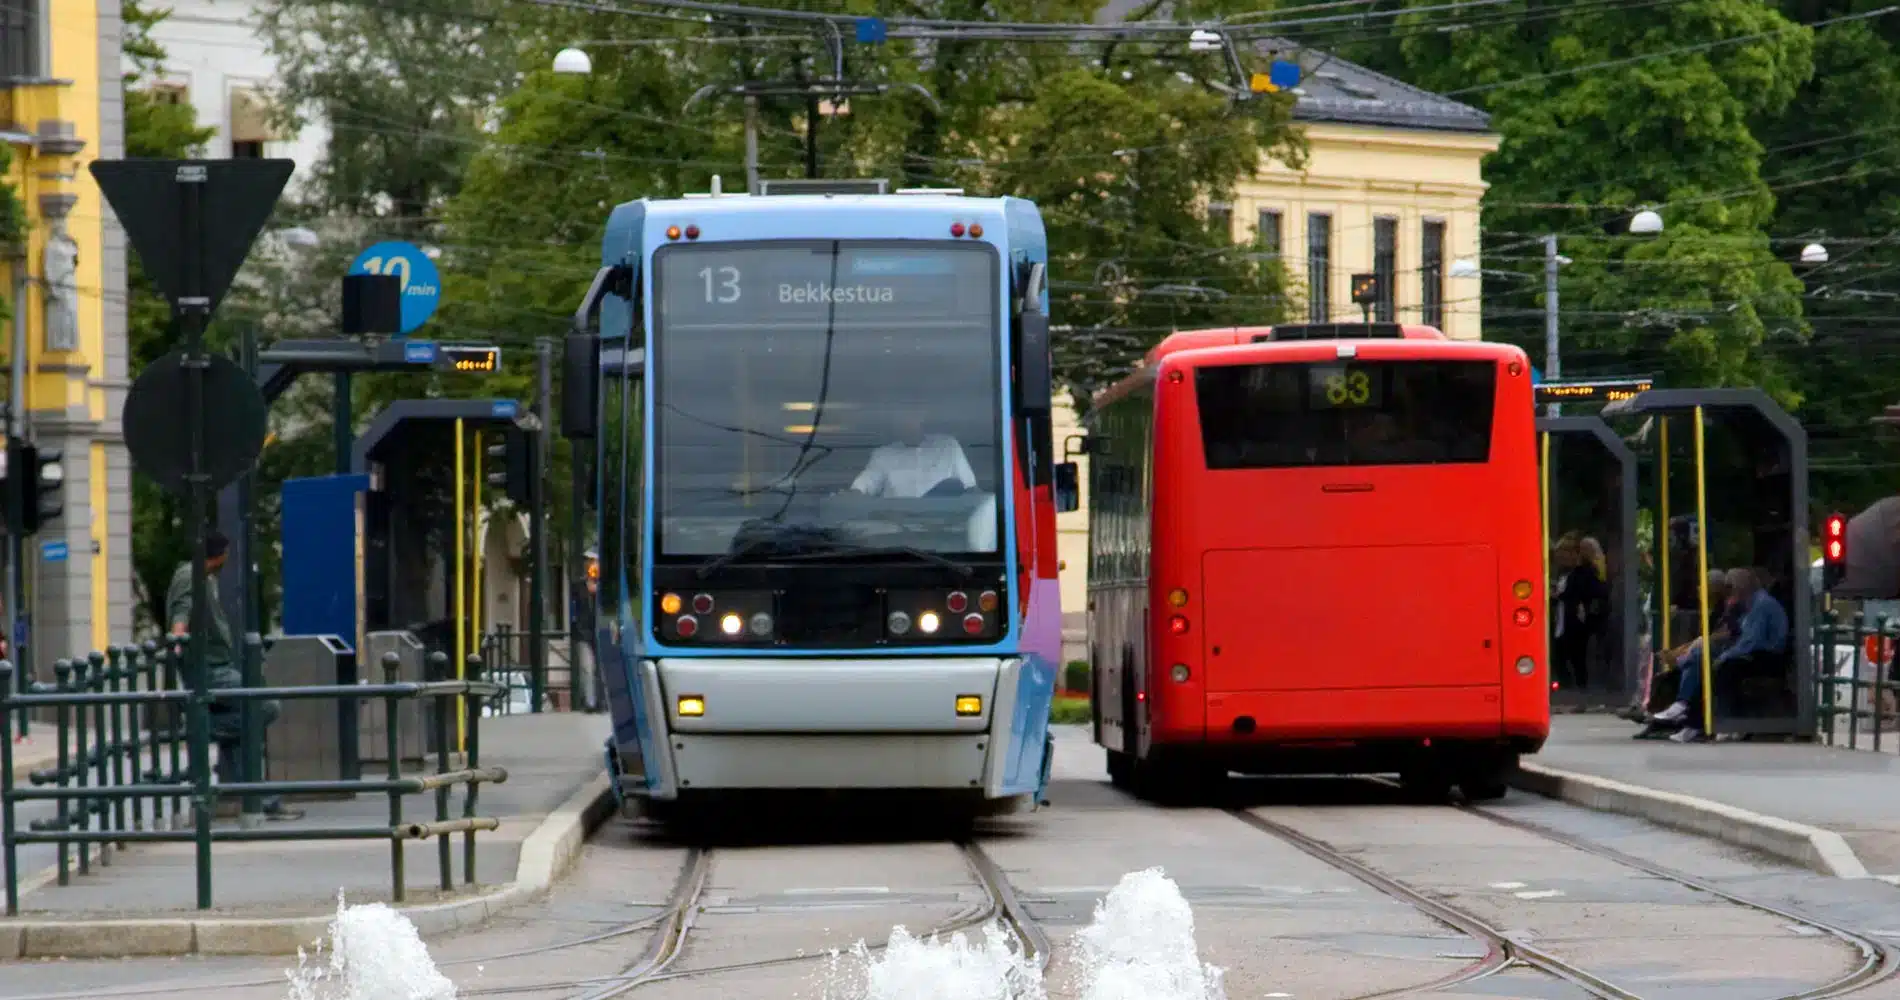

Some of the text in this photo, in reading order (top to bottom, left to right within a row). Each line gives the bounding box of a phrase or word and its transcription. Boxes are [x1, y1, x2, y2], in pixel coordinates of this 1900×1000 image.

[408, 280, 437, 297] min
[698, 264, 894, 304] 13 Bekkestua
[1326, 370, 1370, 404] 83
